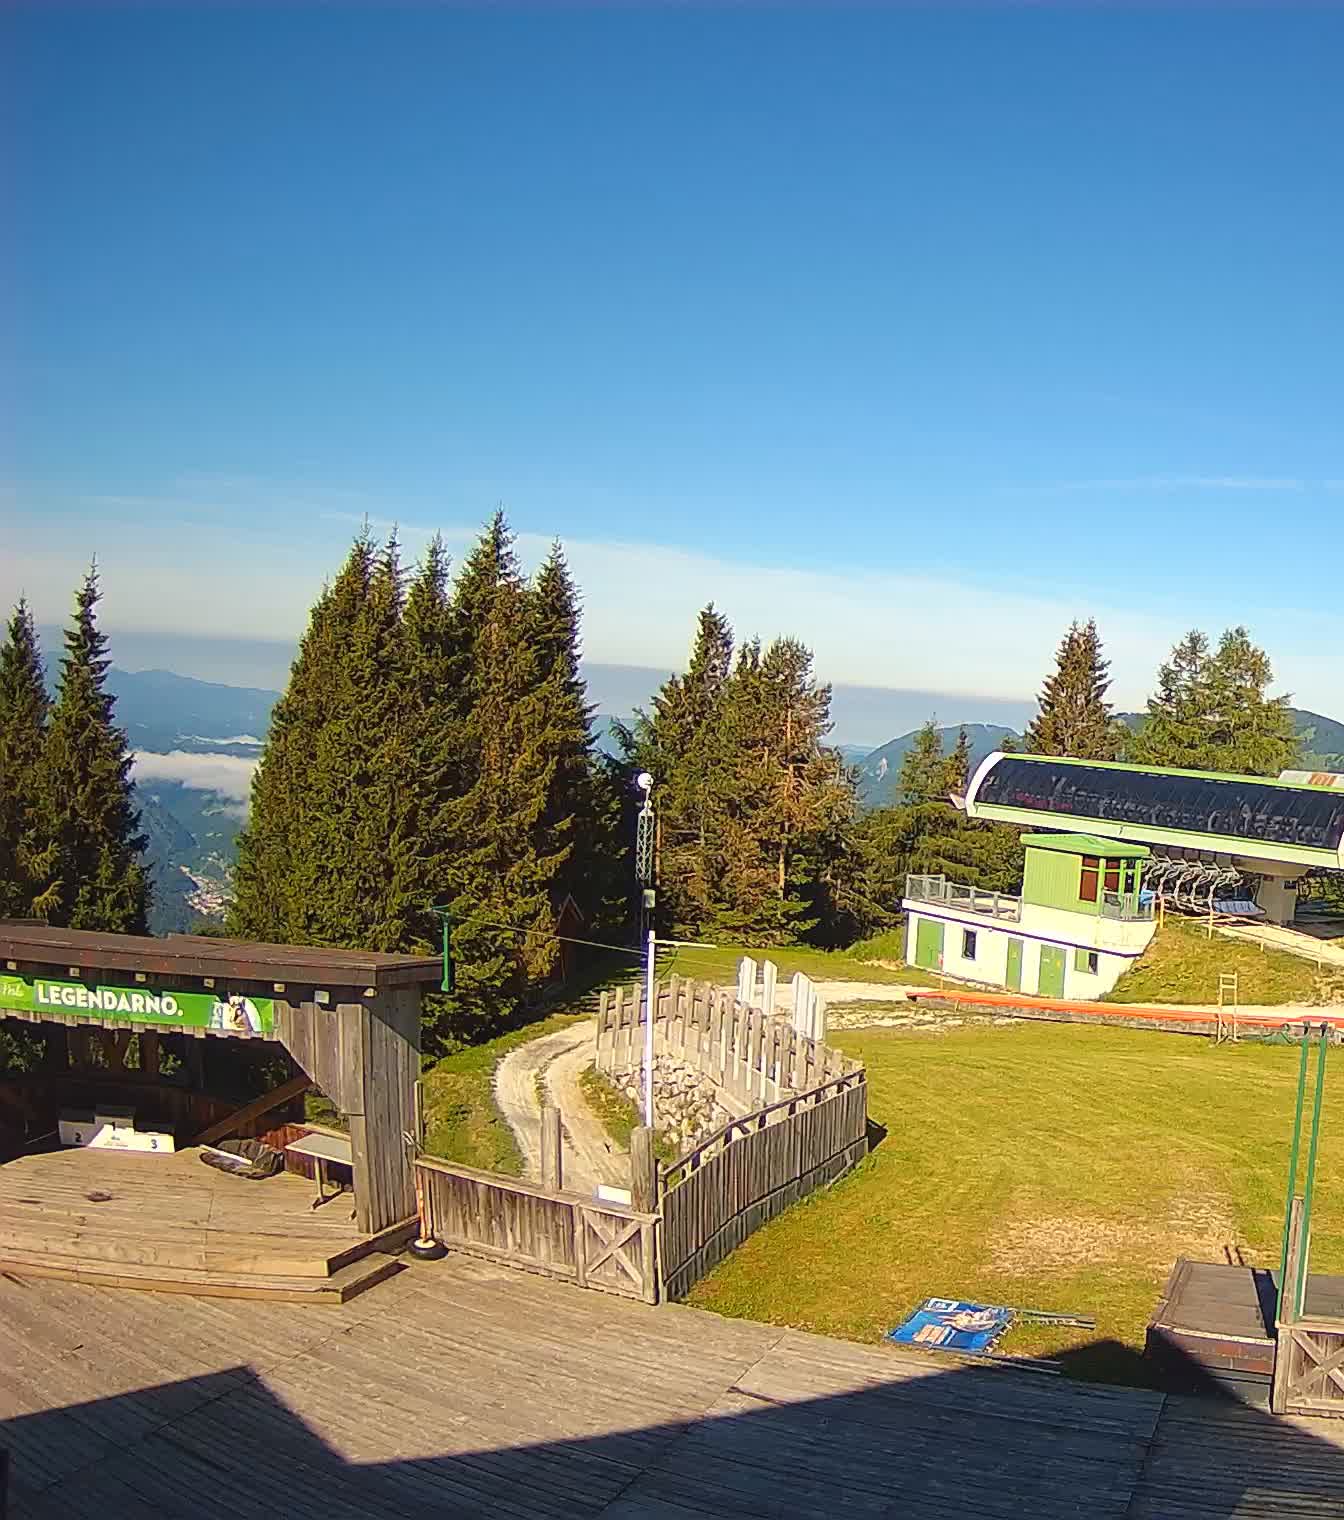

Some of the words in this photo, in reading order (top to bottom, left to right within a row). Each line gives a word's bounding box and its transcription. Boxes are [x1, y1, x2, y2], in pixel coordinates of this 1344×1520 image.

[37, 983, 184, 1017] LEGENDARNO.
[74, 1132, 83, 1143] 2
[150, 1139, 159, 1150] 3
